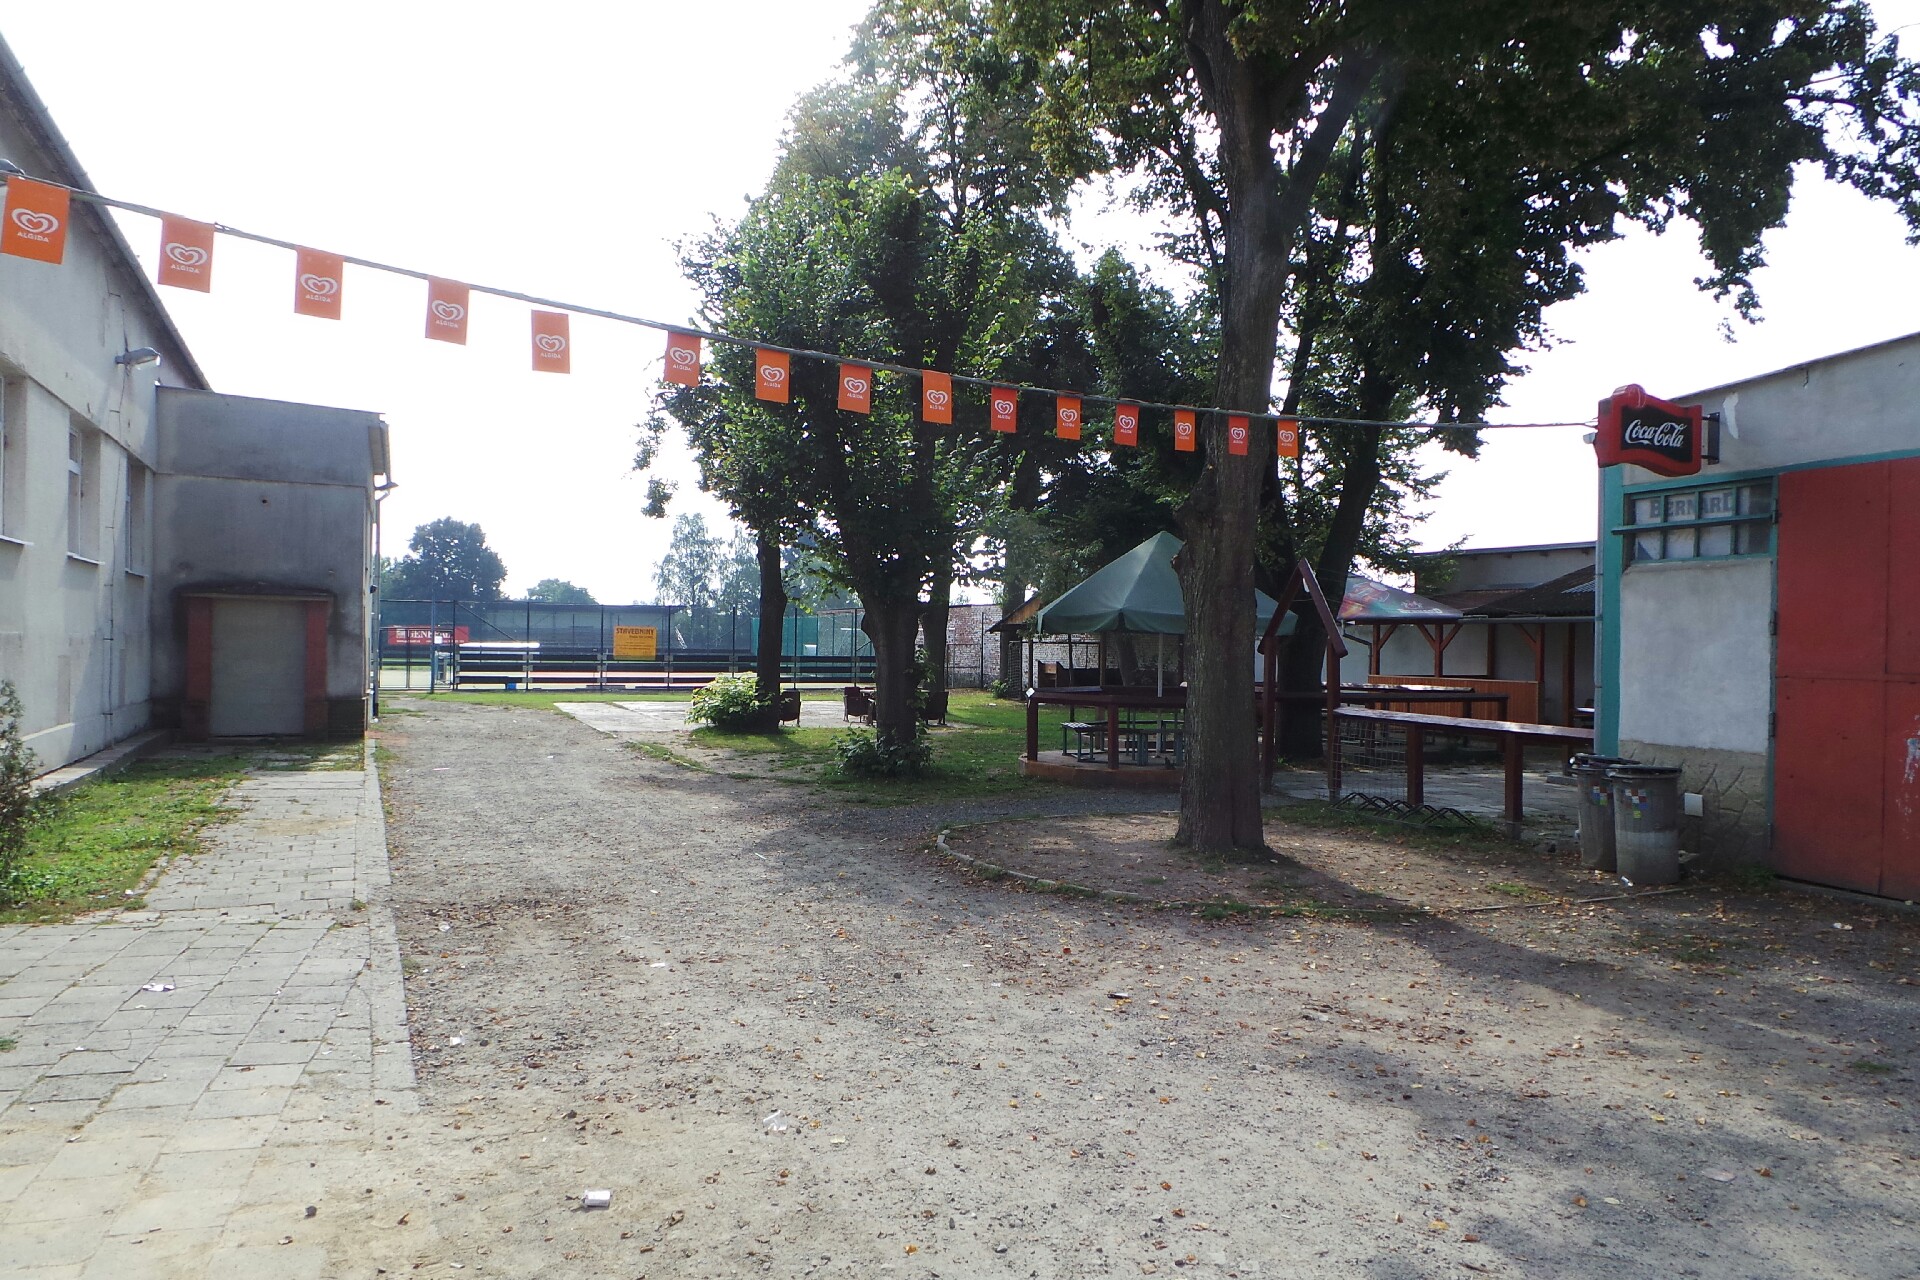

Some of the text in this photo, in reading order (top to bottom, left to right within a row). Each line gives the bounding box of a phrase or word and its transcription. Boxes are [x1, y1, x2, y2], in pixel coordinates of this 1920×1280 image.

[17, 231, 50, 243] ALGIDA
[171, 264, 200, 274] ALGIDA
[305, 294, 332, 303] ALGIDA
[435, 319, 459, 329] ALGIDA
[540, 352, 562, 360] ALGIDA
[1624, 419, 1688, 448] Coca-Cola
